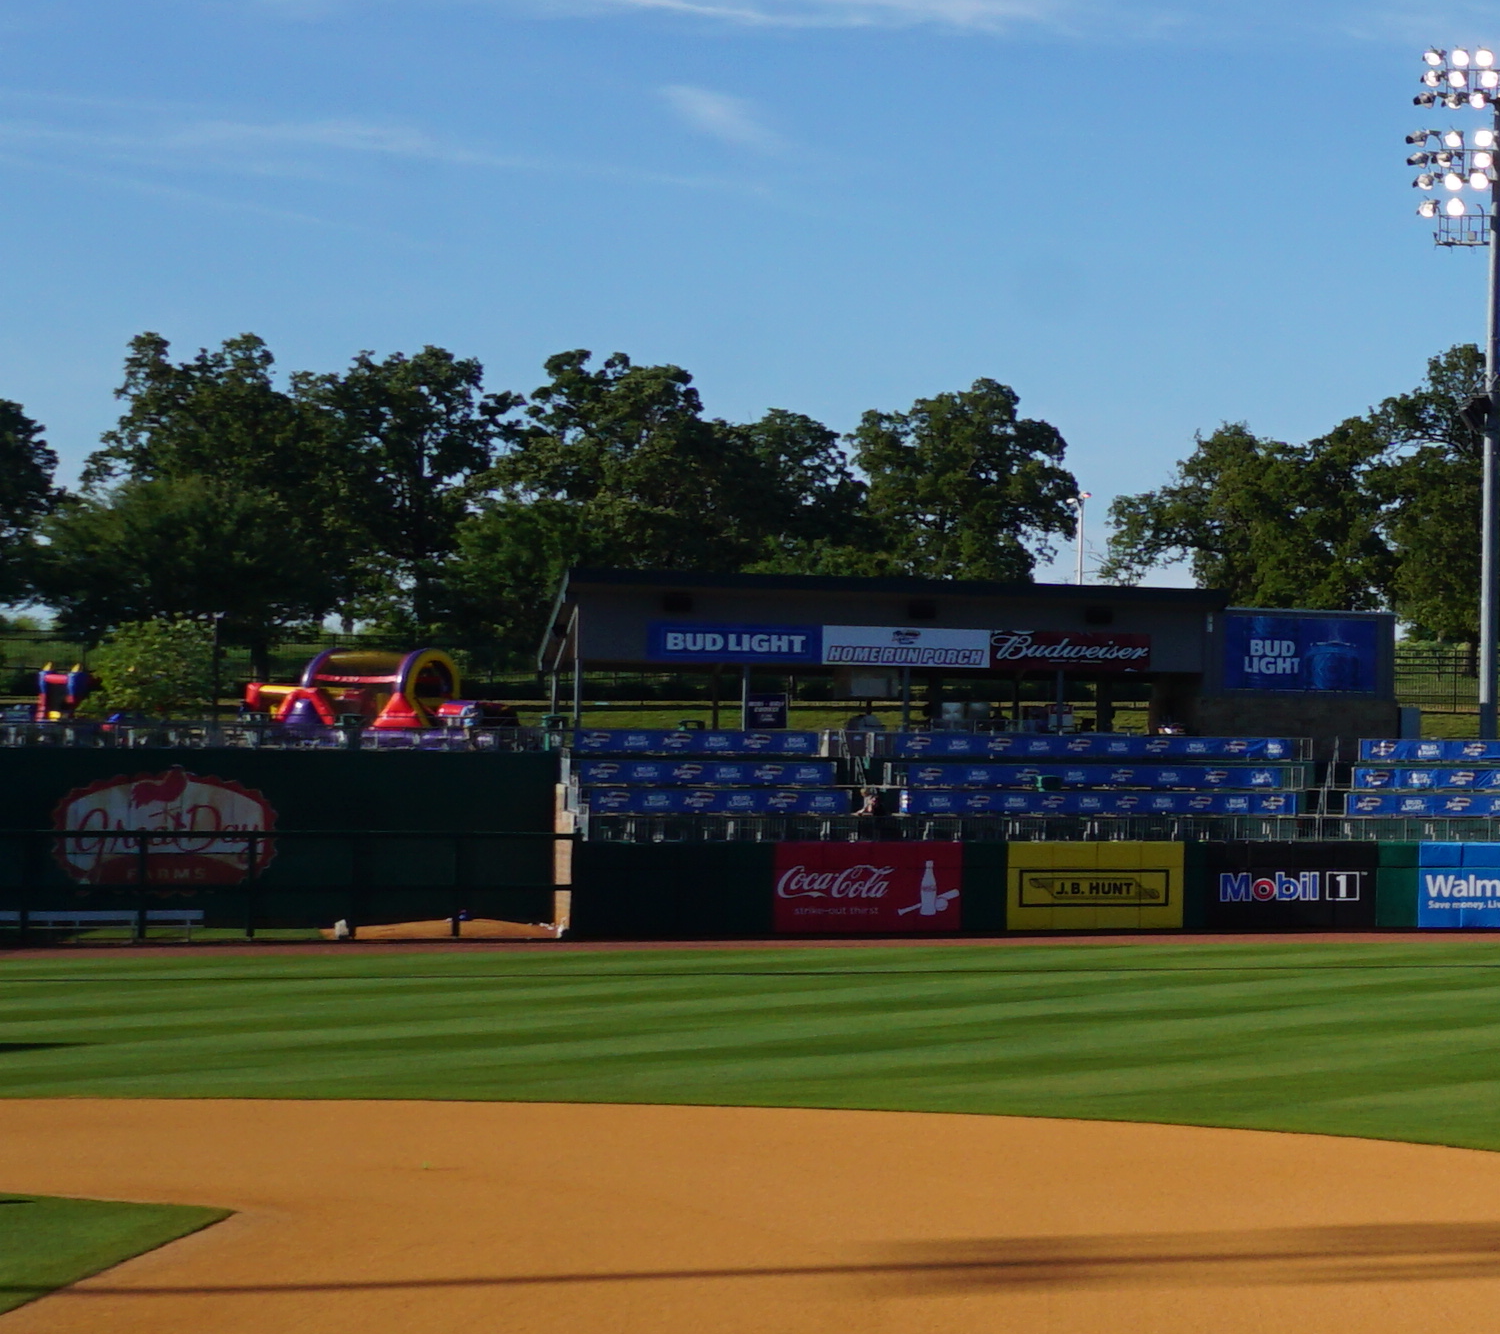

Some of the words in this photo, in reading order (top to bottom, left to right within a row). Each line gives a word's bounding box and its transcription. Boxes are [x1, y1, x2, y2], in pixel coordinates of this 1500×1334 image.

[666, 632, 724, 651] BUD
[728, 634, 805, 653] LIGHT
[991, 634, 1148, 661] Budweiser
[1250, 639, 1296, 657] BUD
[828, 645, 880, 664] HOME
[881, 646, 920, 665] RUN
[921, 647, 983, 665] PORCH
[1244, 656, 1300, 675] LIGHT
[777, 864, 895, 899] Coca-Cola
[1056, 882, 1085, 895] J.B.
[1089, 882, 1133, 895] HUNT
[1219, 871, 1320, 902] Mobil
[1428, 900, 1450, 909] Save
[1452, 901, 1486, 910] money.
